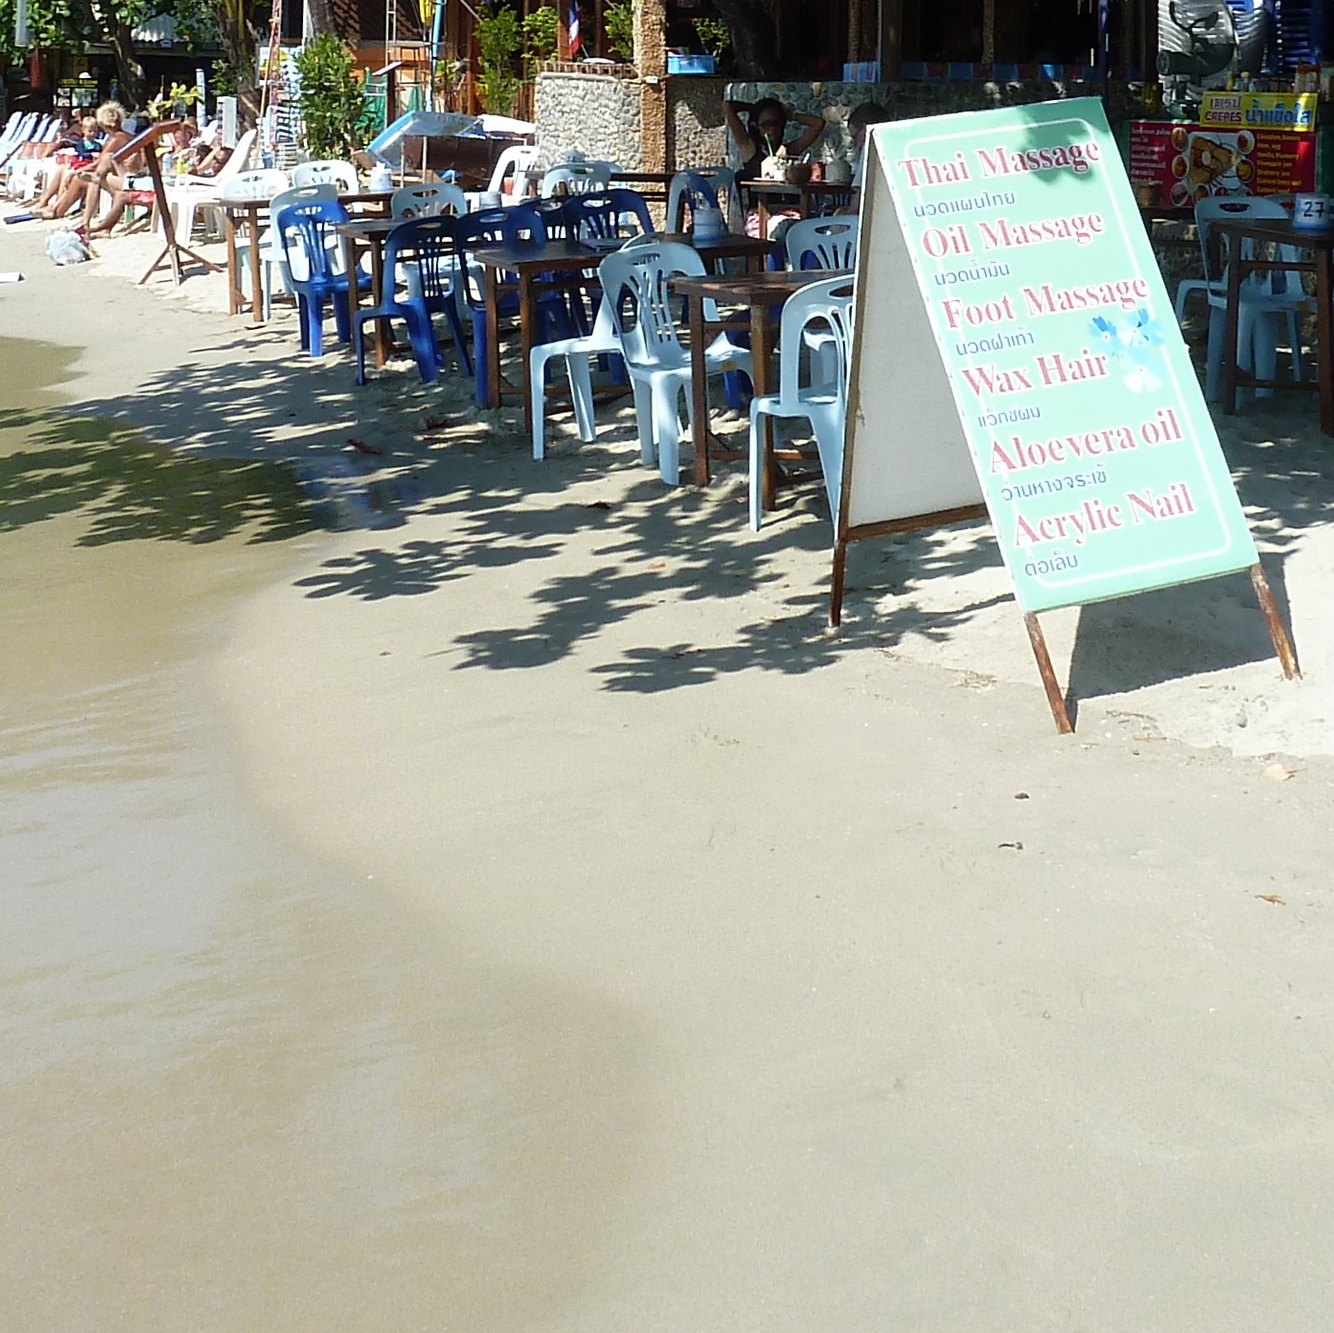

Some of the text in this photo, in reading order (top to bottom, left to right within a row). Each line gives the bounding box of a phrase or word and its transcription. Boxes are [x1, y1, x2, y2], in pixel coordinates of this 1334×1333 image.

[1205, 111, 1242, 123] CREPES
[898, 153, 970, 188] Thai
[976, 142, 1101, 178] Massage
[913, 191, 1016, 217] นวดแผนไทย
[1303, 199, 1325, 219] 27
[923, 214, 1104, 258] Oil Massage
[941, 278, 1148, 328] Foot Massage
[961, 349, 1108, 397] Wax Hair
[991, 409, 1183, 474] Aloevera oil
[1015, 483, 1195, 546] Acrylic Nail
